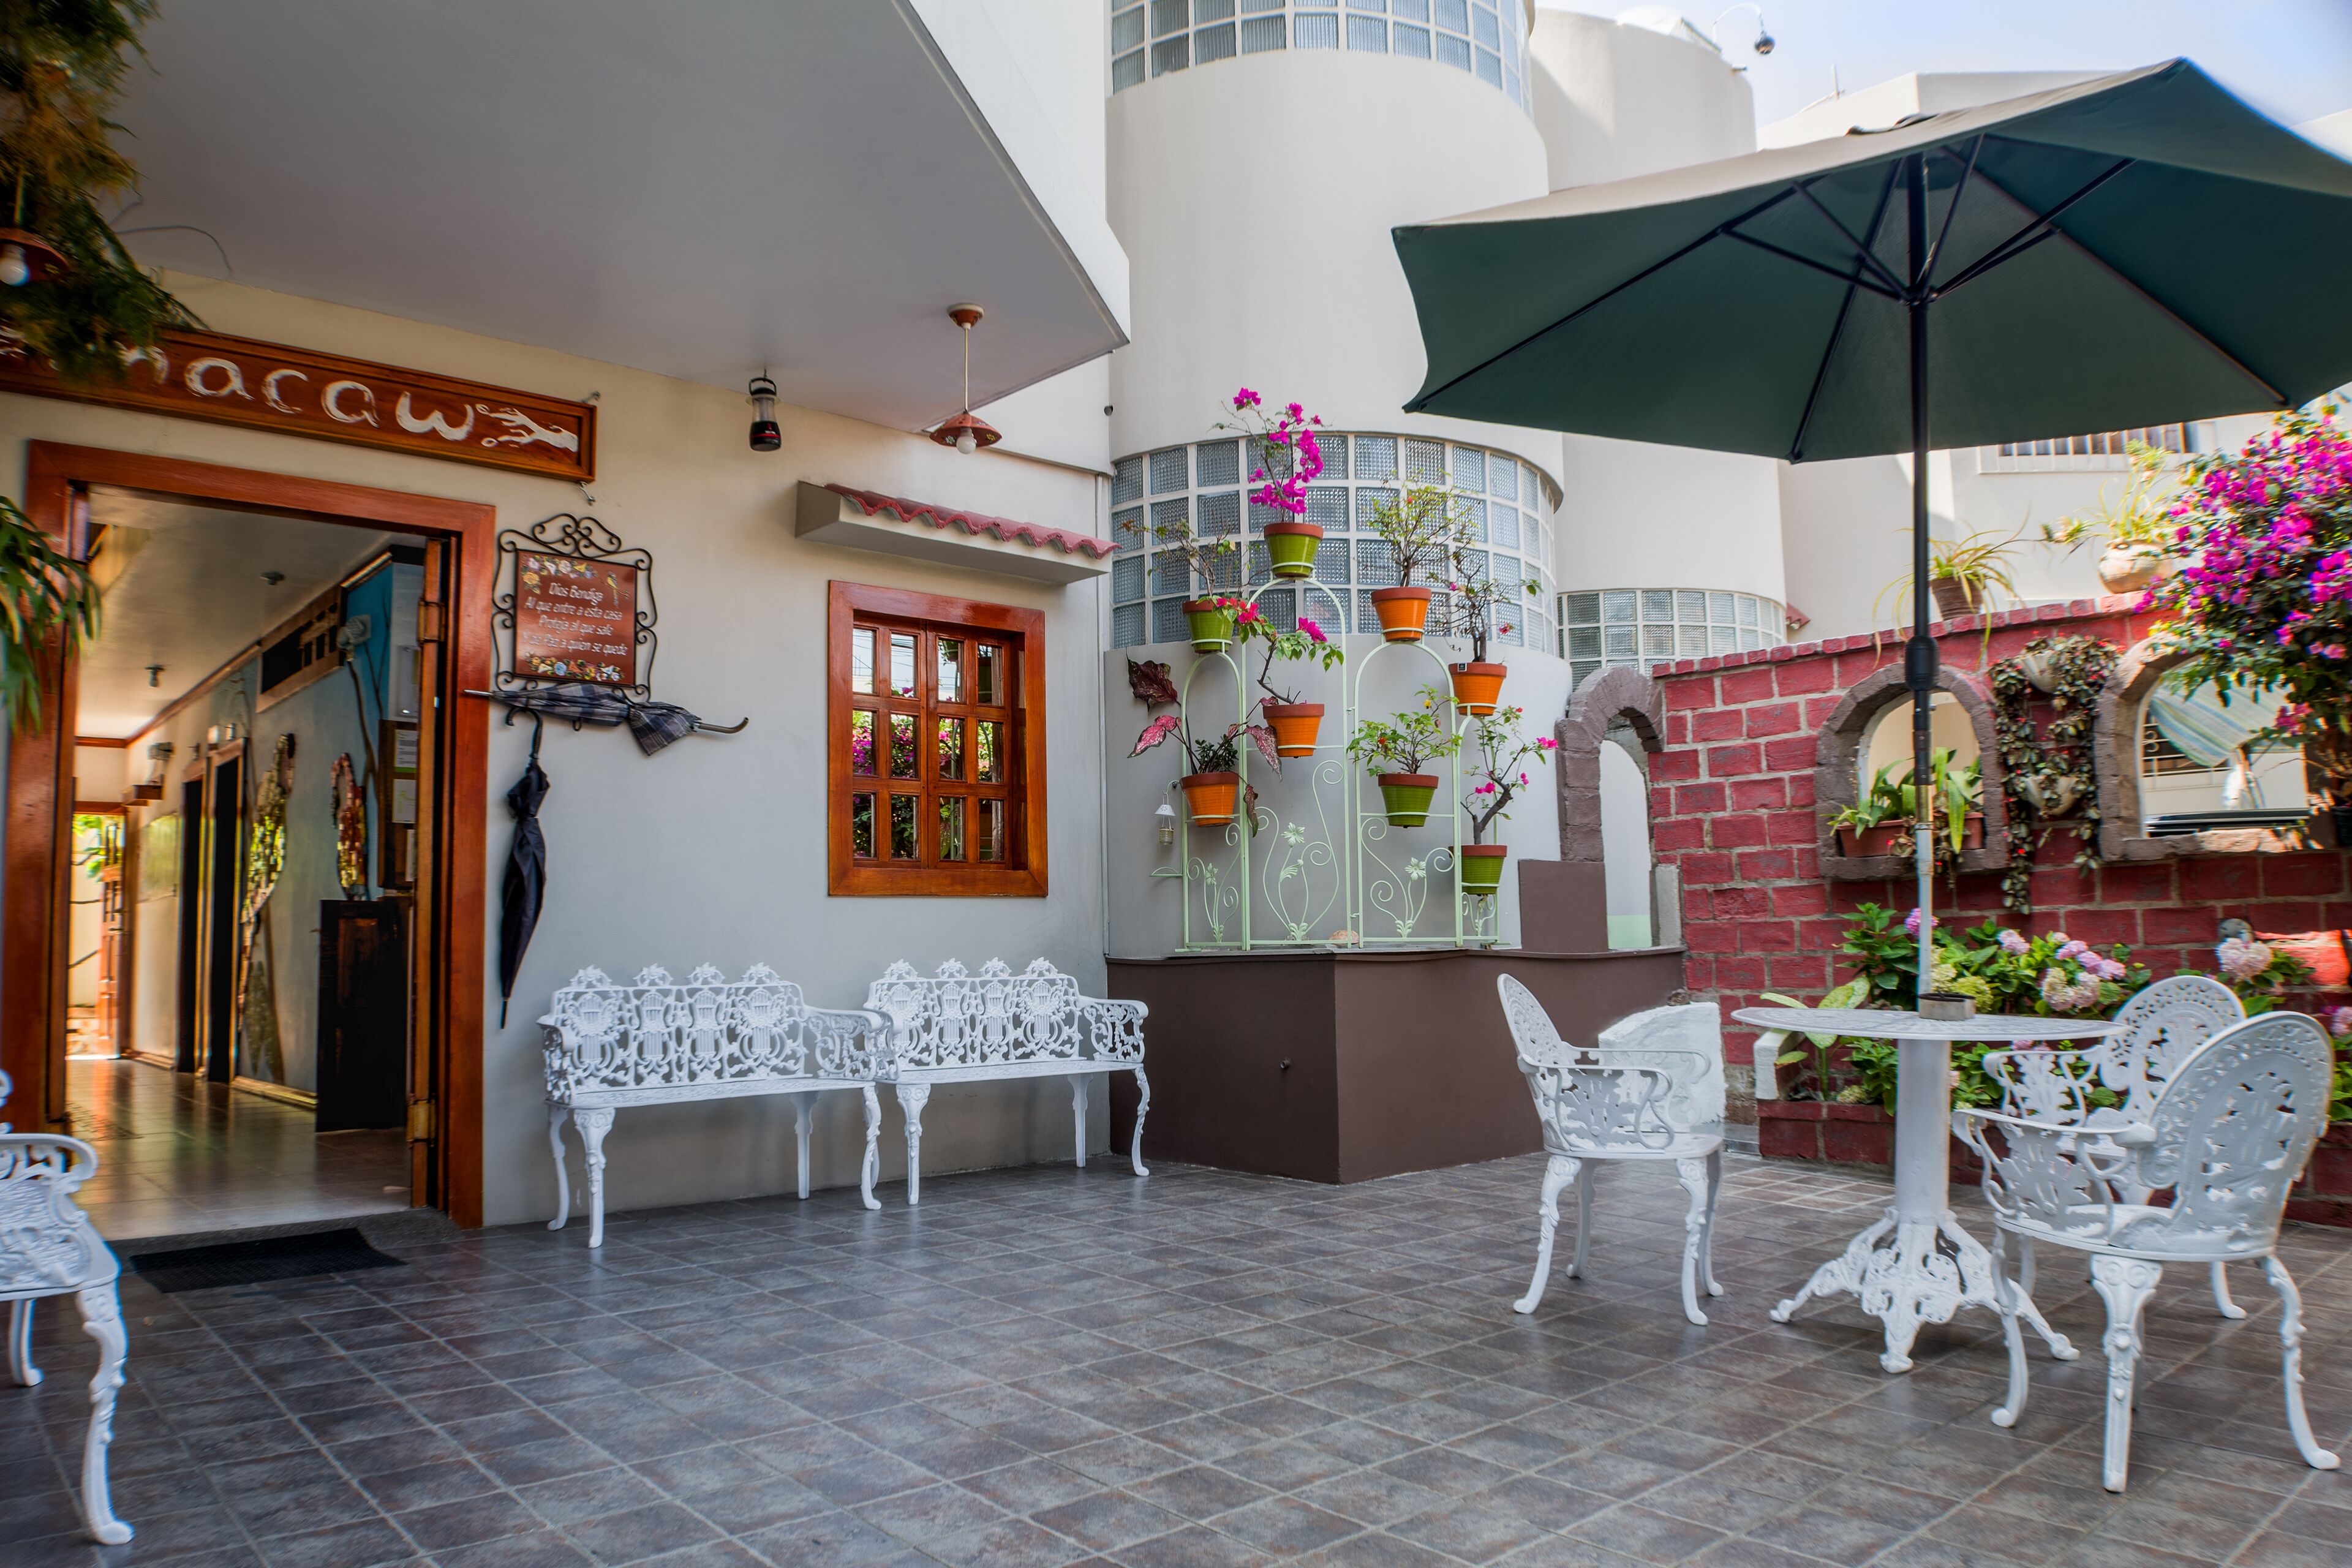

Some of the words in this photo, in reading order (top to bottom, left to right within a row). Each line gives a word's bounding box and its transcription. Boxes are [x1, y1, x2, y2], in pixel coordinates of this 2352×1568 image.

[549, 582, 569, 597] Dios
[524, 596, 537, 609] Al
[536, 601, 552, 614] que
[553, 603, 576, 615] entre
[576, 607, 584, 616] a
[584, 606, 603, 619] esta
[603, 610, 623, 621] casa
[569, 619, 580, 631] al
[579, 624, 596, 636] que
[595, 624, 614, 636] sale
[543, 633, 559, 647] Paz
[559, 639, 567, 648] a
[567, 637, 591, 652] quien
[590, 643, 603, 652] se
[602, 643, 628, 657] quede
